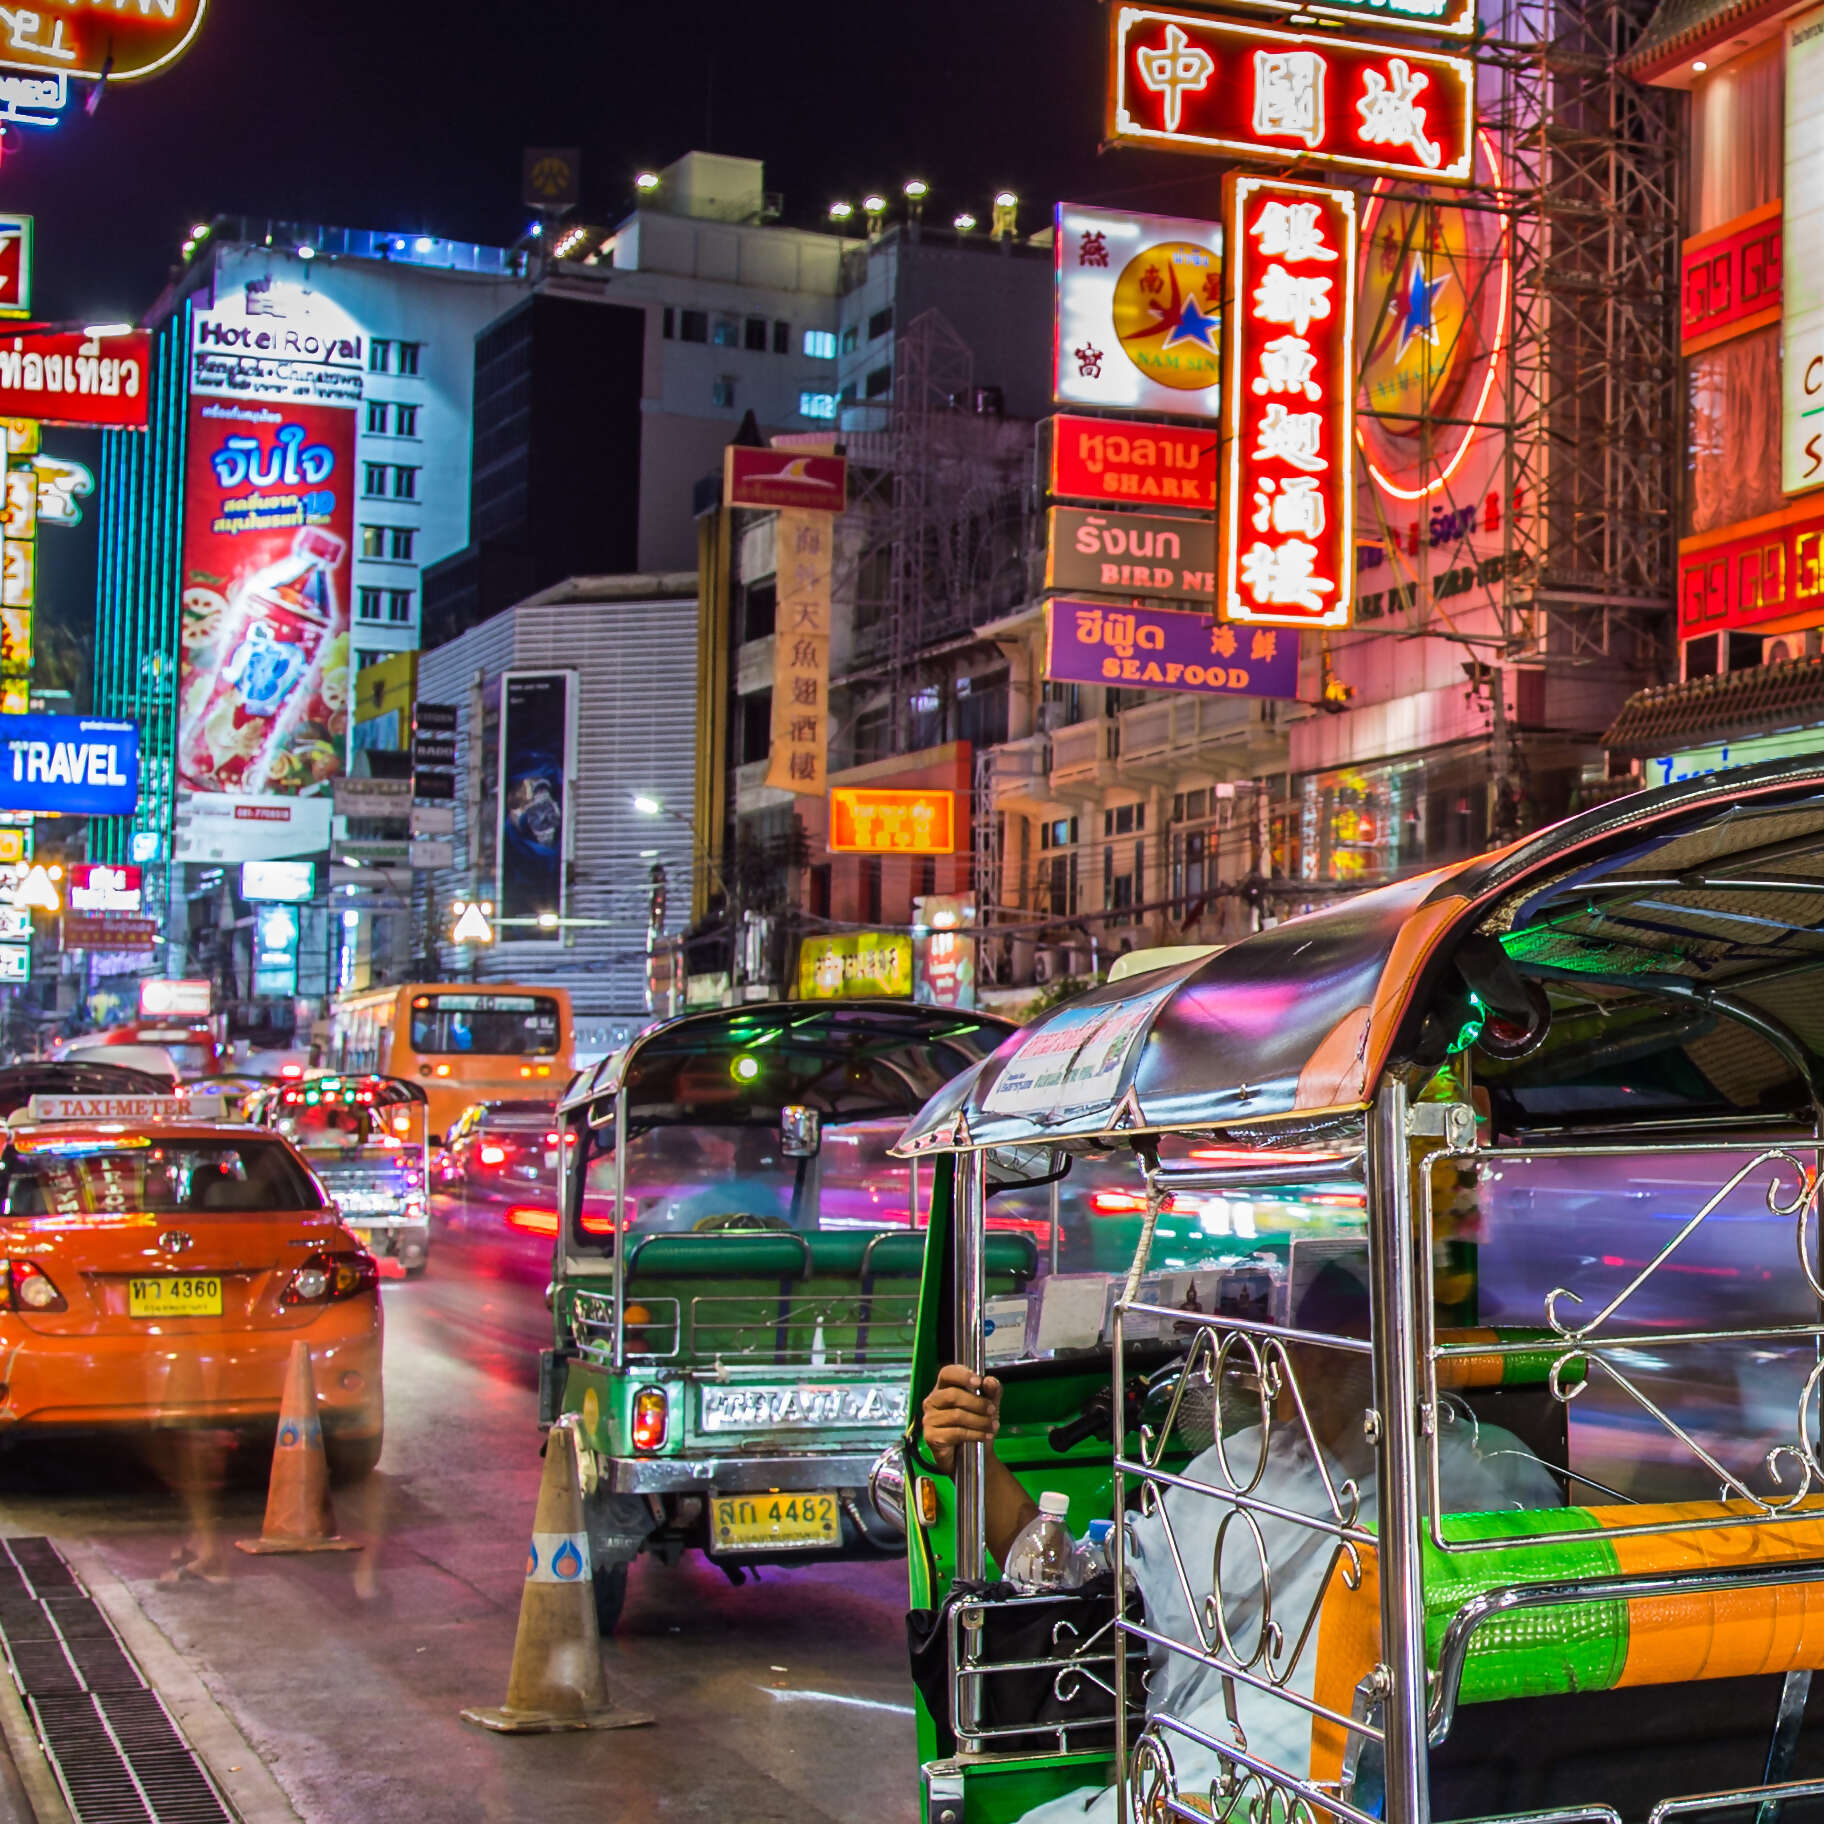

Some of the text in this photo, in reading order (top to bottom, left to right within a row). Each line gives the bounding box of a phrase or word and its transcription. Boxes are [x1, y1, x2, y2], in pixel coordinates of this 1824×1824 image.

[1137, 24, 1441, 168] 中國城
[199, 320, 362, 363] Hotel Royal
[211, 424, 335, 488] จับใจ
[1079, 433, 1199, 472] หูฉลาม
[1103, 473, 1199, 499] SHARK
[1075, 516, 1180, 559] รังนก
[1101, 563, 1174, 588] BIRD
[1102, 658, 1250, 689] SEAFOOD
[10, 741, 127, 787] TRAVEL
[59, 1099, 193, 1117] TAXI-METER
[170, 1280, 217, 1298] 4360
[769, 1498, 832, 1523] 4482
